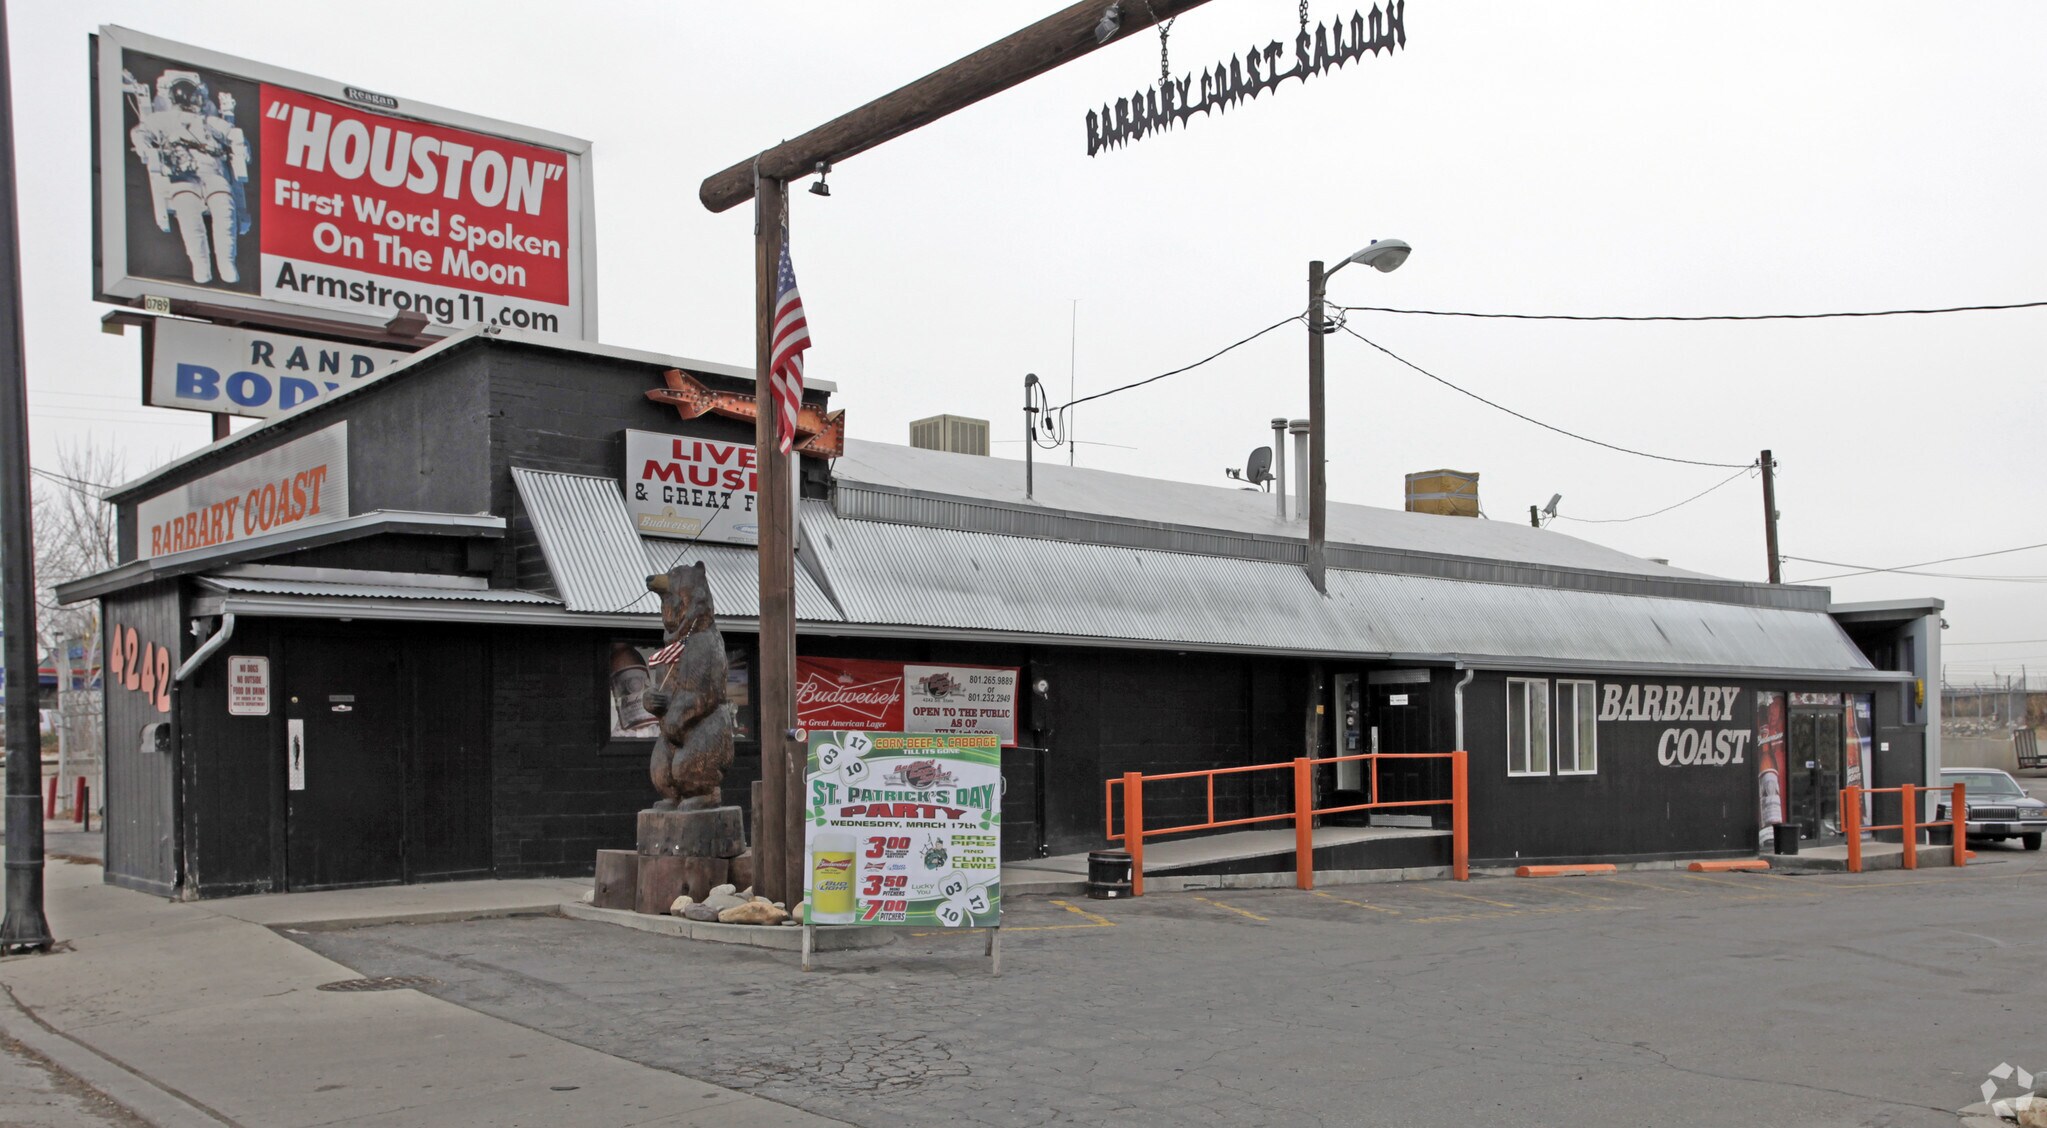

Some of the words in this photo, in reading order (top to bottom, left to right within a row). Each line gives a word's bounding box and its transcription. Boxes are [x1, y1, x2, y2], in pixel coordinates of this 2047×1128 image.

[1086, 71, 1191, 158] BARBARY
[1199, 39, 1284, 117] COAST
[1295, 0, 1406, 84] SALOON
[348, 88, 395, 105] Reagan
[275, 178, 345, 217] First
[352, 194, 440, 237] Word
[449, 214, 561, 259] Spoken
[313, 222, 364, 259] On
[372, 233, 431, 272] The
[442, 246, 527, 288] Moon
[147, 298, 168, 312] 0789
[275, 262, 559, 333] Armstrong11.com
[250, 340, 398, 378] RAND
[672, 439, 757, 469] LIVE
[635, 483, 649, 501] &
[663, 485, 732, 509] GREAT
[151, 496, 240, 557] BARBARY
[244, 464, 328, 536] COAST
[640, 515, 699, 531] Budweiser
[111, 623, 171, 713] 4242
[797, 682, 900, 704] Budweiser
[1598, 683, 1740, 722] BARBARY
[913, 706, 940, 716] OPEN
[943, 707, 956, 717] TO
[958, 708, 978, 717] THE
[980, 708, 1010, 718] PUBLIC
[808, 718, 829, 727] Great
[830, 719, 866, 727] American
[866, 720, 887, 729] Lager
[950, 718, 962, 728] AS
[965, 719, 978, 728] OF
[849, 736, 867, 750] 17
[875, 737, 903, 748] CORN
[907, 737, 933, 748] BEEF
[936, 737, 944, 748] &
[949, 737, 997, 748] CABBAGE
[1657, 728, 1751, 767] COAST
[823, 748, 839, 765] 03
[845, 762, 862, 777] 10
[813, 780, 842, 807] ST.
[848, 786, 950, 804] PATRICK'S
[956, 783, 996, 811] DAY
[840, 803, 968, 820] PARTY
[830, 820, 902, 829] WEDNESDAY,
[906, 821, 947, 829] MARCH
[952, 862, 997, 870] LEWIS
[911, 883, 935, 891] Lucky
[945, 881, 962, 896] 03
[968, 895, 985, 911] 17
[880, 912, 905, 921] PITCHERS
[941, 907, 959, 922] 10
